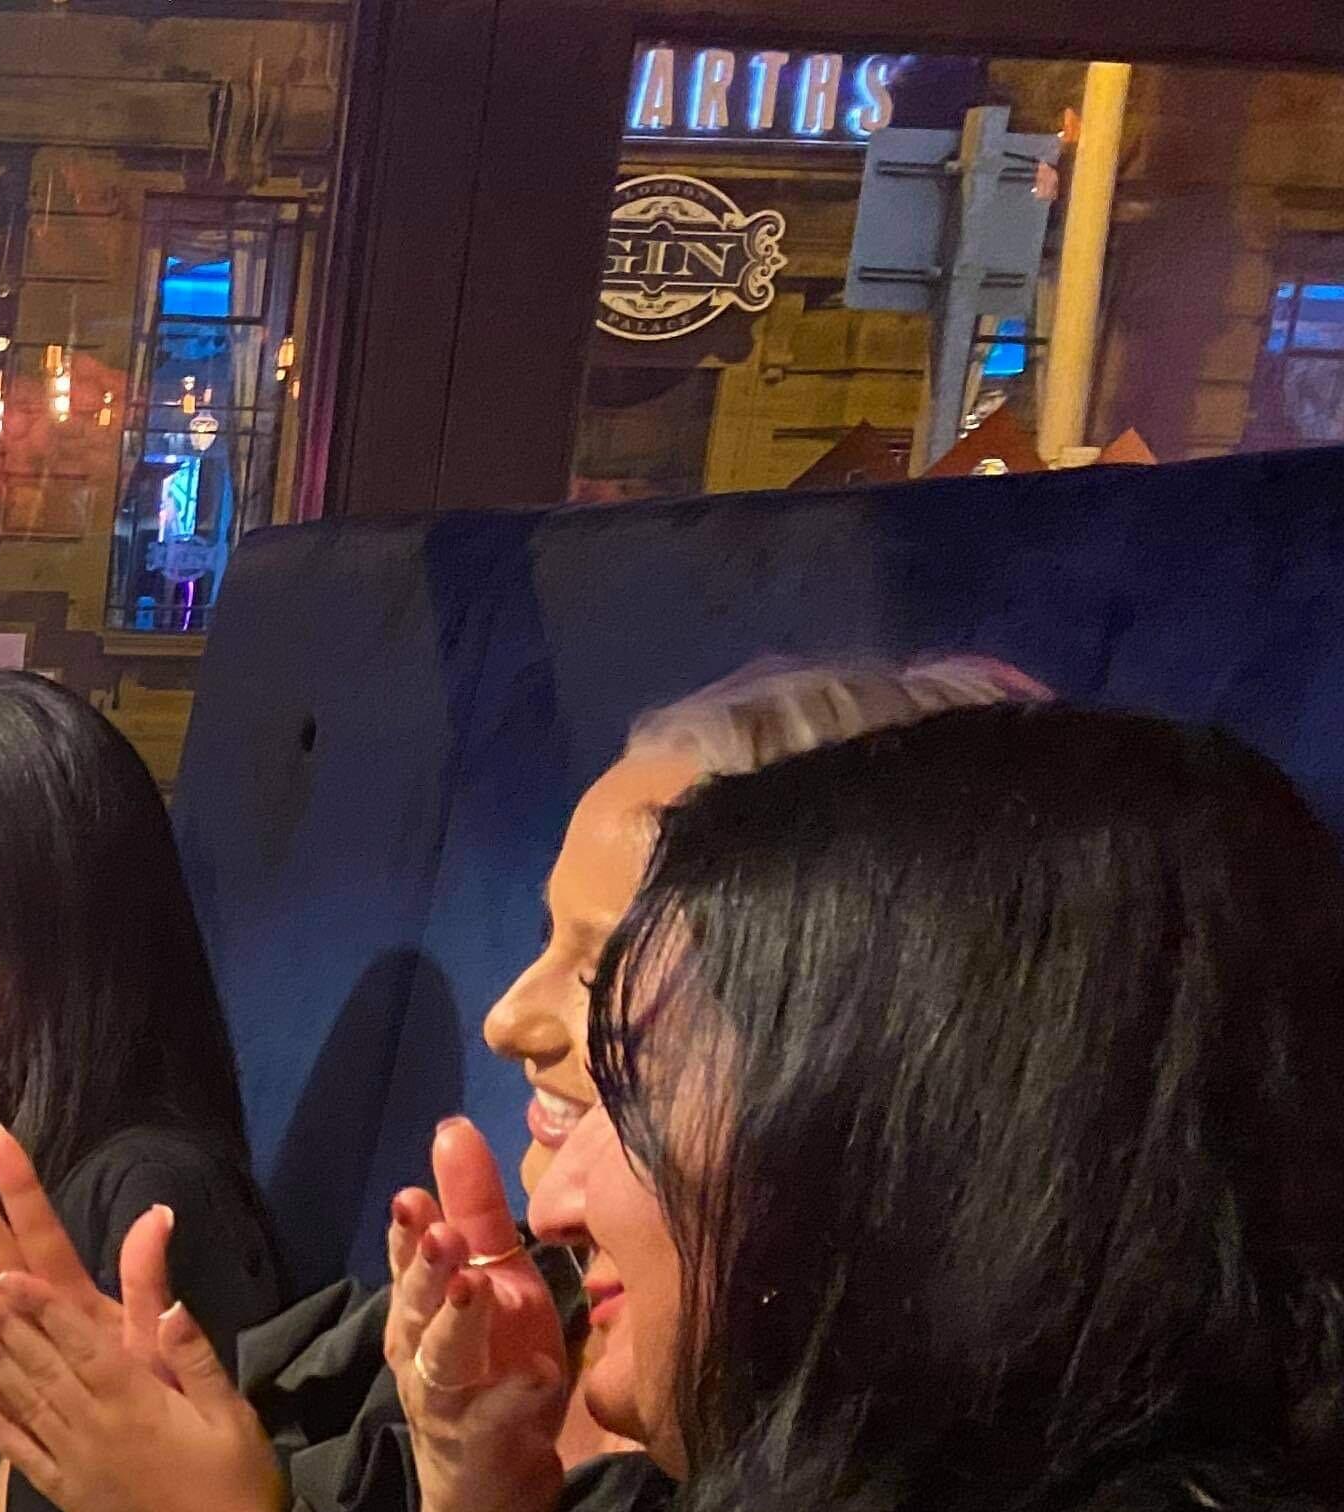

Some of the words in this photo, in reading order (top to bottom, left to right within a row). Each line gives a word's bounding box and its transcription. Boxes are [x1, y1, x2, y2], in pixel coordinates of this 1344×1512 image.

[629, 49, 894, 133] ARTHS
[625, 182, 710, 200] LONDON
[603, 238, 736, 277] GIN
[606, 312, 691, 332] PALACE
